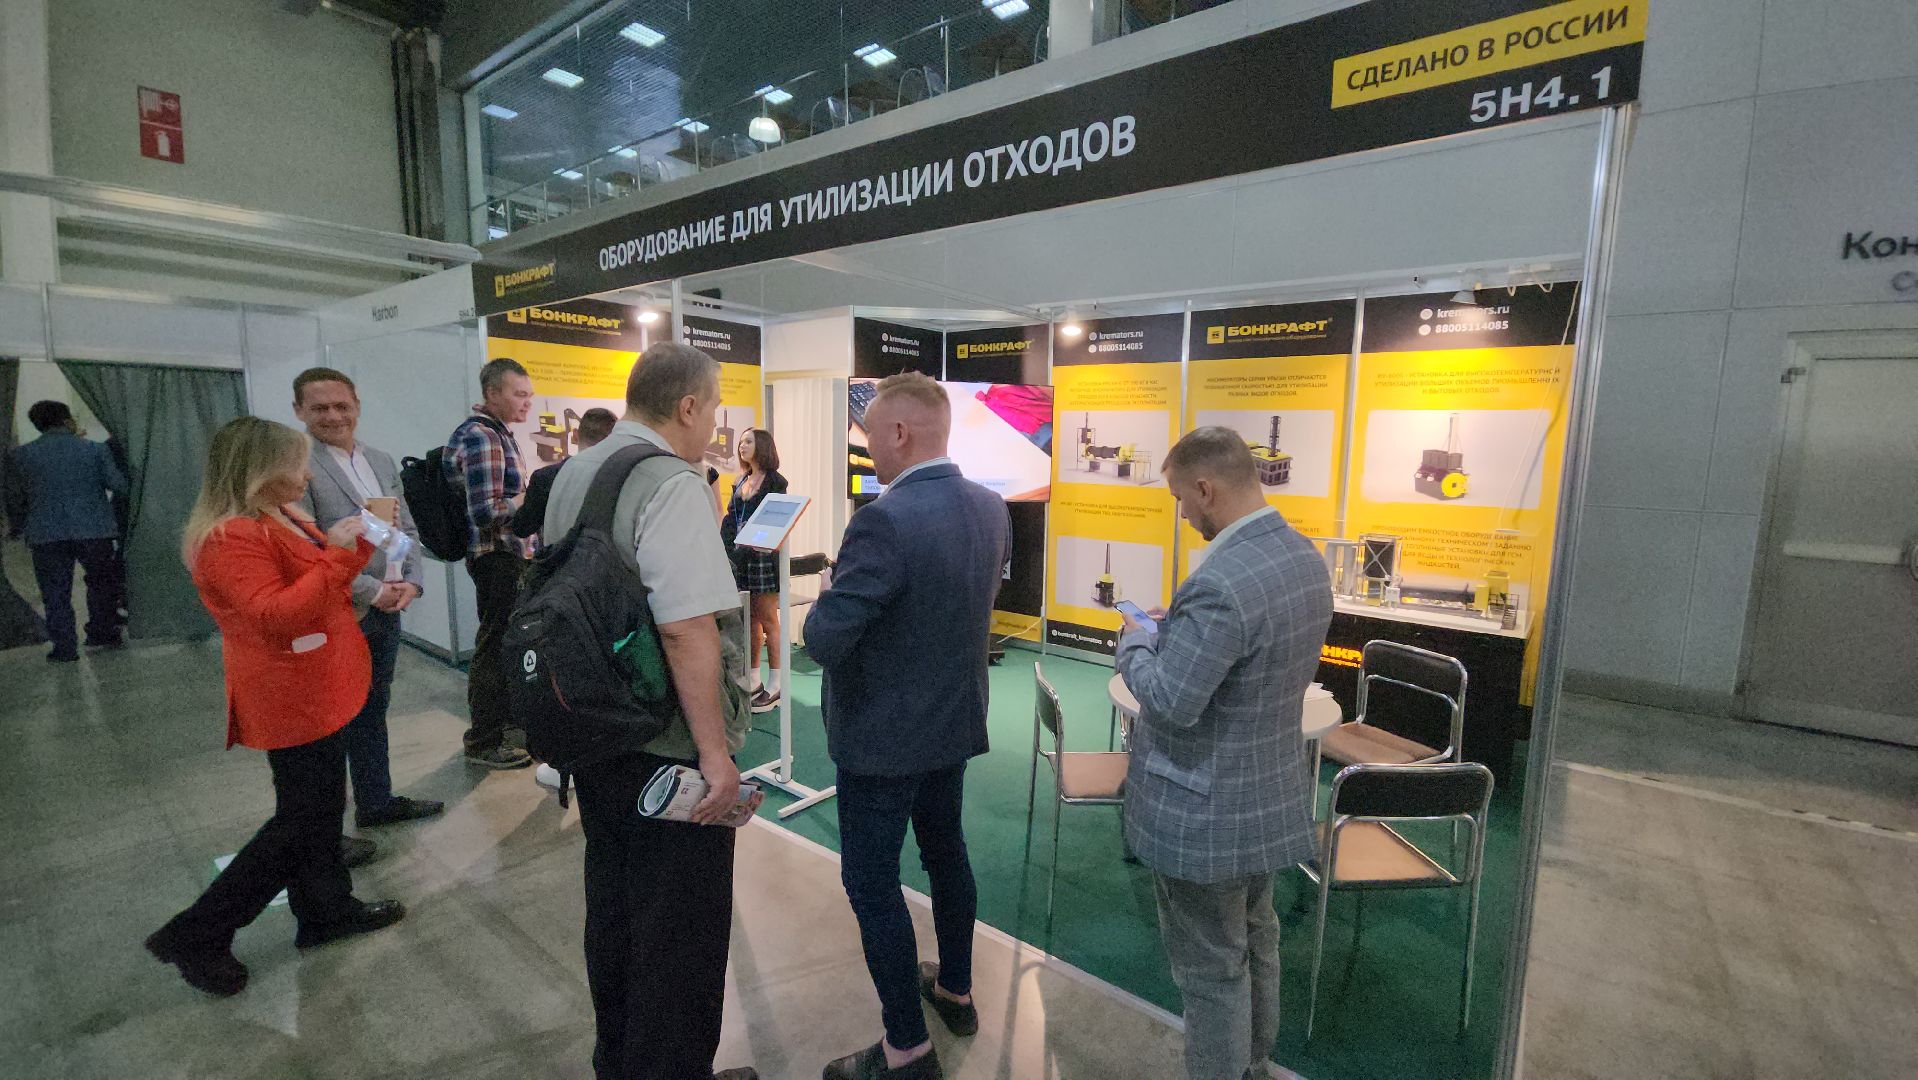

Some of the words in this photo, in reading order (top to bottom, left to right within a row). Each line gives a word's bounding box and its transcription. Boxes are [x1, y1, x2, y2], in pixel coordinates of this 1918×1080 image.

[1347, 45, 1469, 91] СДЕЛАНО
[1477, 37, 1495, 61] В
[1504, 6, 1629, 54] РОССИИ
[599, 214, 726, 271] ОБОРУДОВАНИЕ
[730, 203, 772, 243] ДЛЯ
[780, 158, 954, 228] УТИЛИЗАЦИИ
[963, 114, 1137, 188] ОТХОДОВ
[505, 262, 555, 288] БОНКРАФТ
[529, 306, 621, 329] БОНКРАФТ
[692, 327, 731, 340] kremators.ru
[1227, 320, 1328, 337] БОНКРАФТ
[1435, 320, 1509, 334] 88005114085
[889, 334, 920, 347] kremators.ru
[1098, 330, 1144, 340] kremators.ru
[969, 340, 1032, 353] БОНКРАФТ
[1098, 342, 1144, 352] 88005114085
